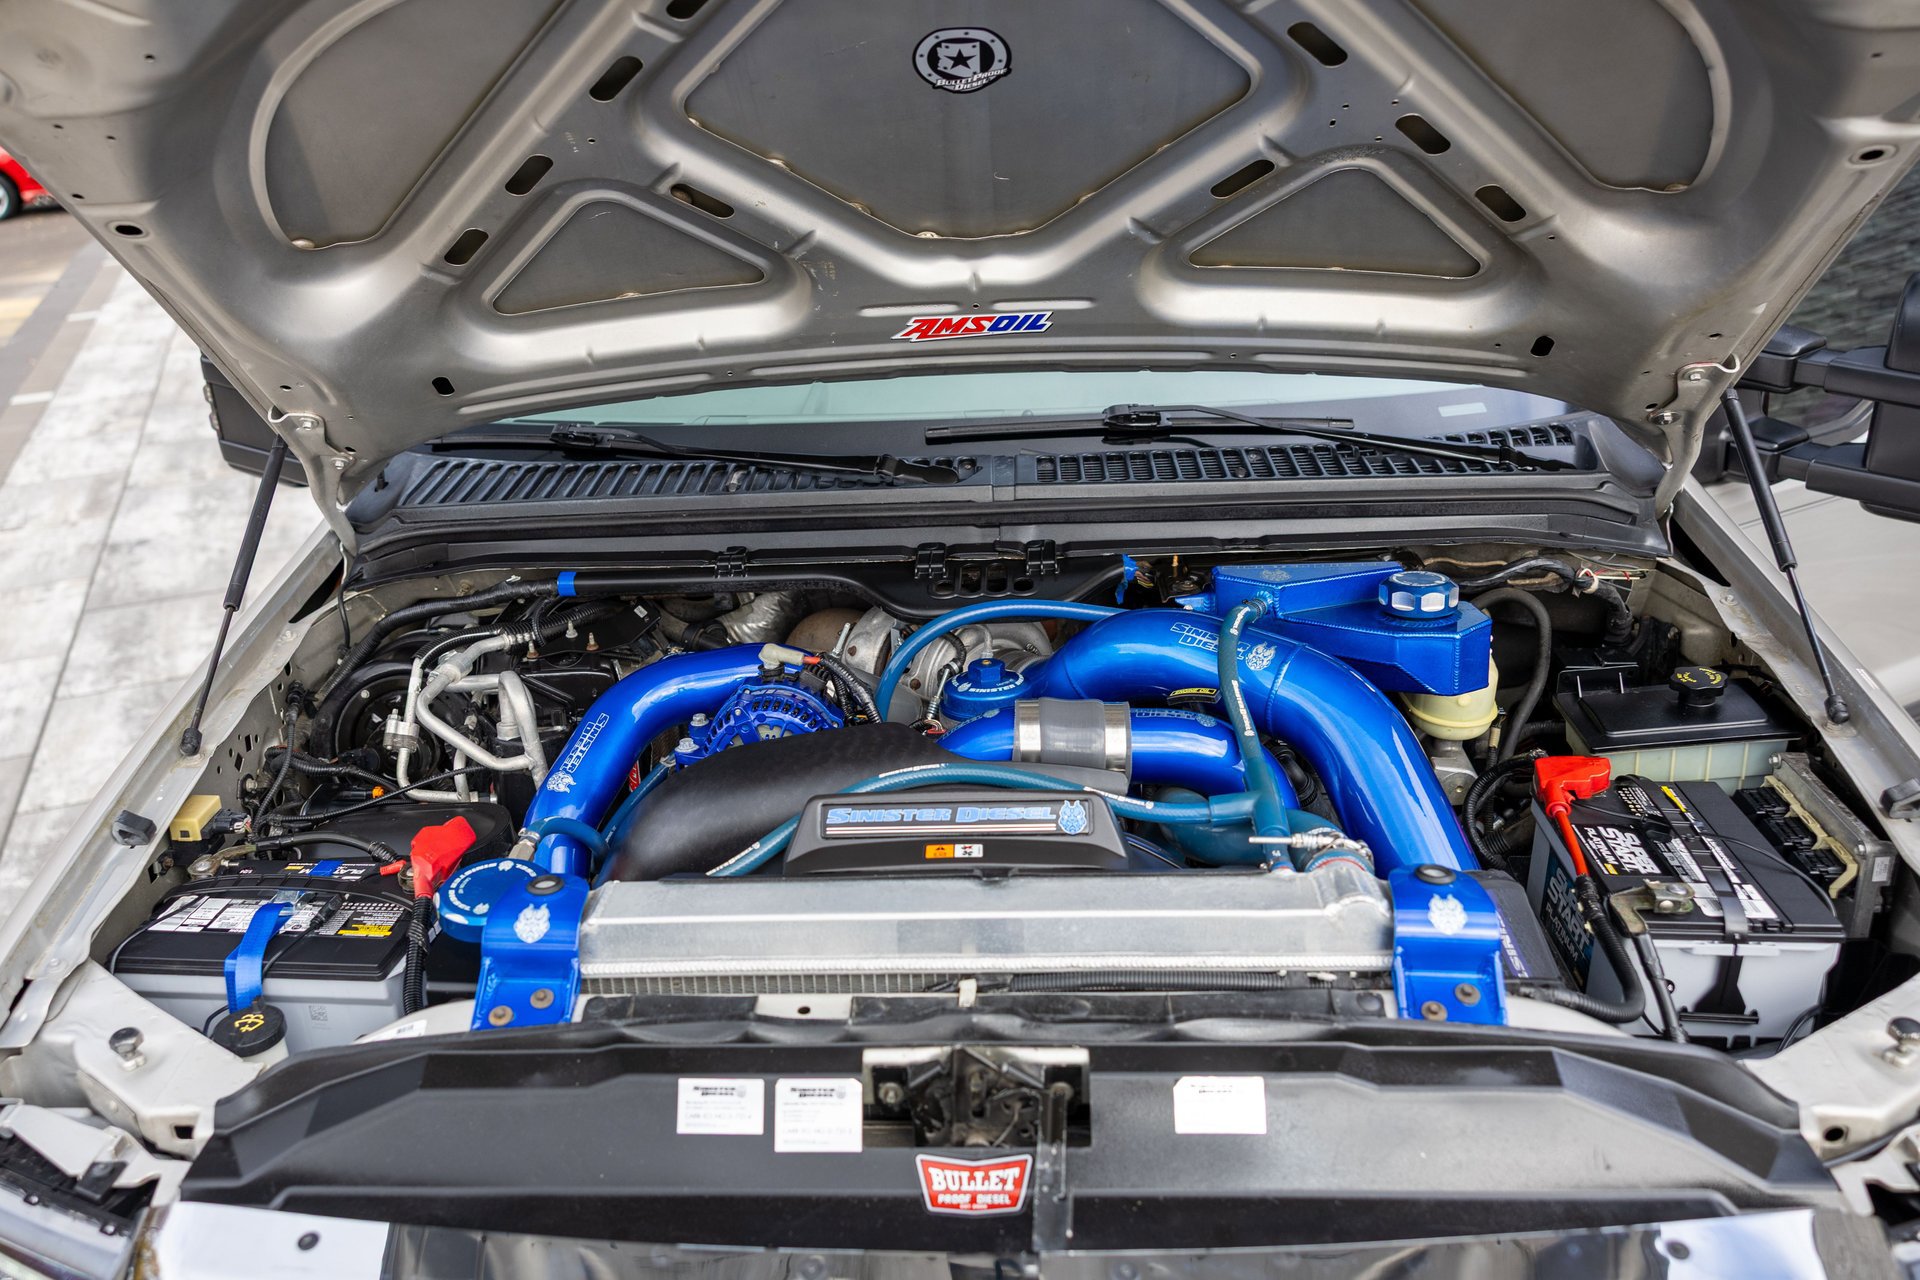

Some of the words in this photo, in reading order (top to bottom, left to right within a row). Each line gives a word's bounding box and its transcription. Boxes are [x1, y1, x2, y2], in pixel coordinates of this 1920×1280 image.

[900, 313, 1048, 340] AMSOIL
[826, 807, 952, 824] SINISTER
[956, 806, 1057, 823] DIESEL
[1583, 827, 1620, 865] PLATINUM
[1596, 826, 1649, 875] START
[1622, 832, 1662, 874] SUPER
[928, 1166, 1020, 1191] BULLET
